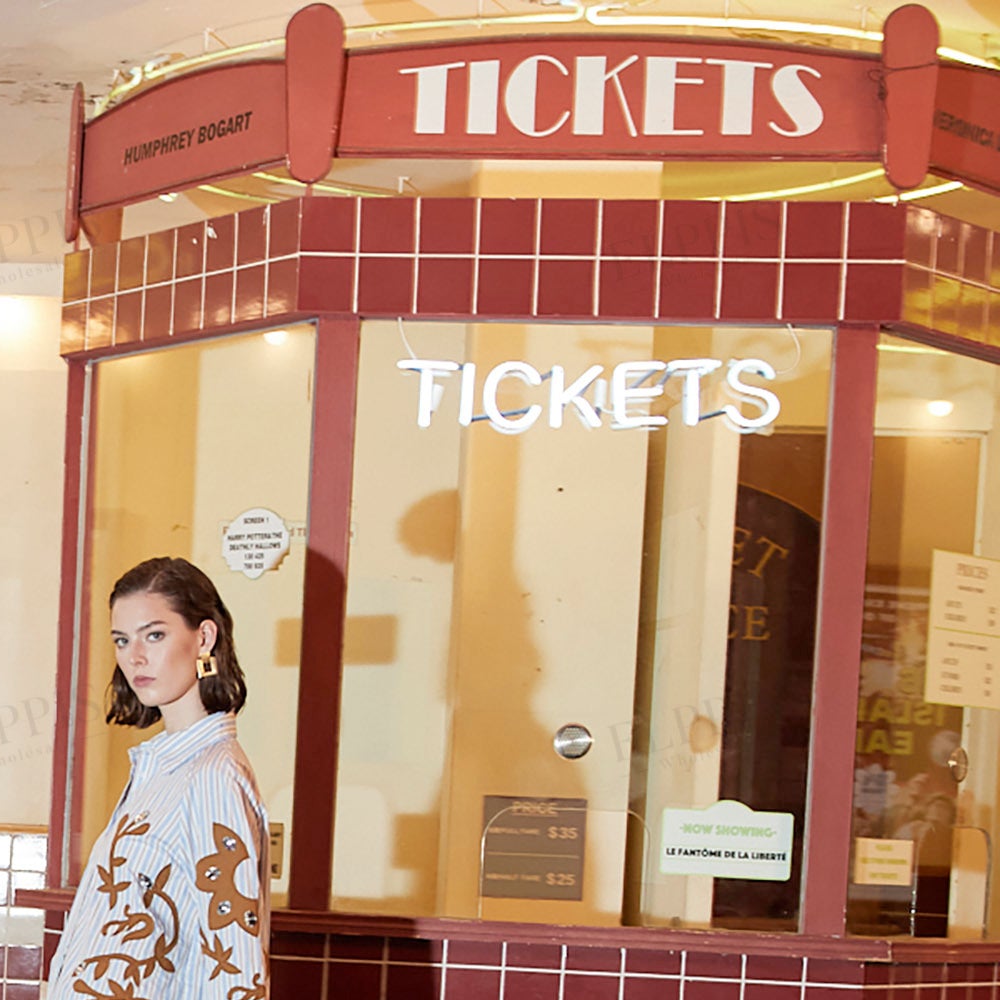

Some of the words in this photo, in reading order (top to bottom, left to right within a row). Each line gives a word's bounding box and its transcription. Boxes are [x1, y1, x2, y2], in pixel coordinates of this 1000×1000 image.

[398, 53, 825, 138] TICKETS
[123, 128, 195, 166] HUMPHREY
[197, 111, 253, 145] BOGART
[396, 358, 781, 432] TICKETS
[227, 533, 245, 541] HARRY
[511, 801, 558, 815] PRICE
[547, 826, 578, 839] $35
[666, 848, 675, 856] LE
[678, 848, 721, 858] FANTÔME
[724, 850, 736, 859] DE
[738, 851, 749, 859] LA
[751, 851, 786, 862] LIBERTÉ
[545, 872, 576, 886] $25
